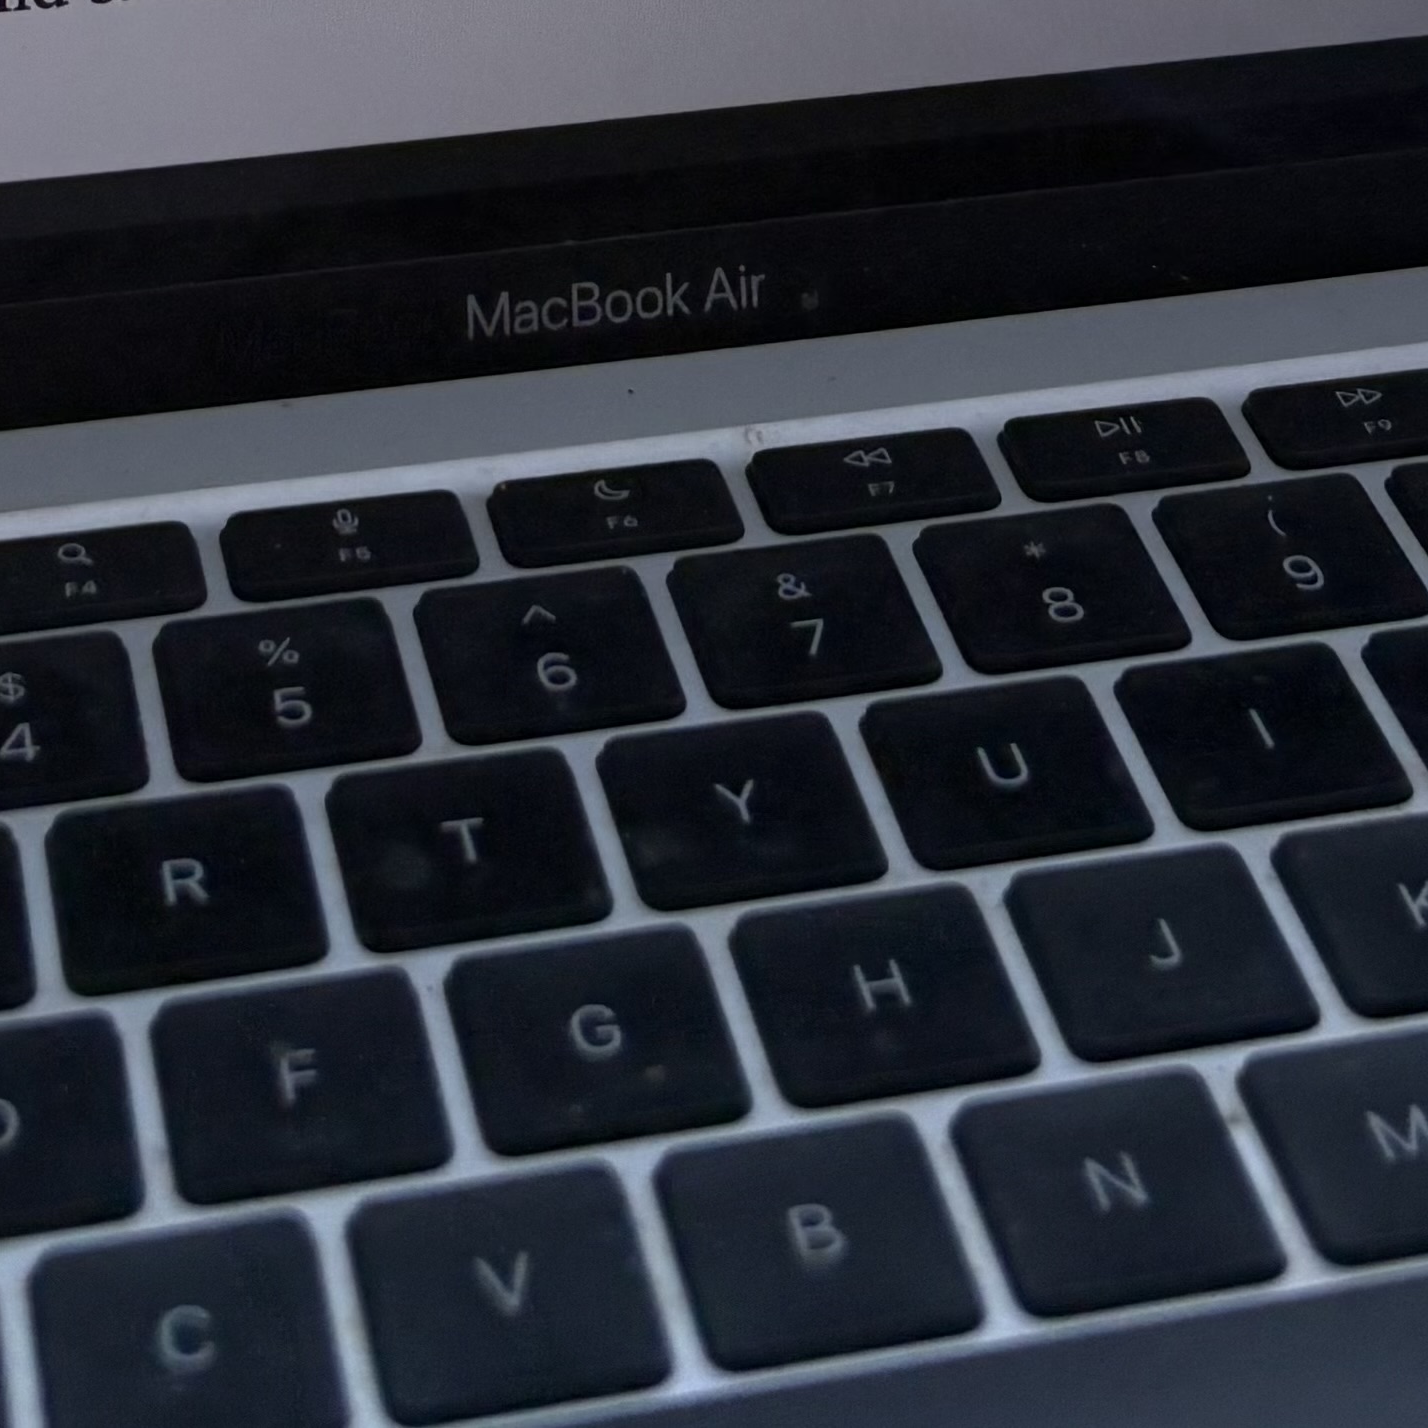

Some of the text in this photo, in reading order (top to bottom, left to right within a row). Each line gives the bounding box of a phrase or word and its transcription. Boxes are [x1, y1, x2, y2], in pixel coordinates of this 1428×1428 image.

[465, 264, 766, 340] MacBook Air
[1282, 554, 1325, 591] 9
[1041, 586, 1085, 624] 8
[790, 618, 825, 656] 7
[536, 652, 578, 692] 6
[273, 686, 313, 728] 5
[1248, 708, 1275, 749] I
[976, 742, 1030, 788] U
[714, 779, 754, 823] Y
[441, 817, 484, 864] T
[160, 858, 209, 906] R
[1150, 918, 1183, 969] J
[853, 958, 912, 1012] H
[568, 1004, 623, 1059] G
[278, 1048, 317, 1103] F
[1083, 1152, 1149, 1211] N
[787, 1203, 847, 1264] B
[475, 1251, 529, 1316] V
[156, 1305, 215, 1374] C
